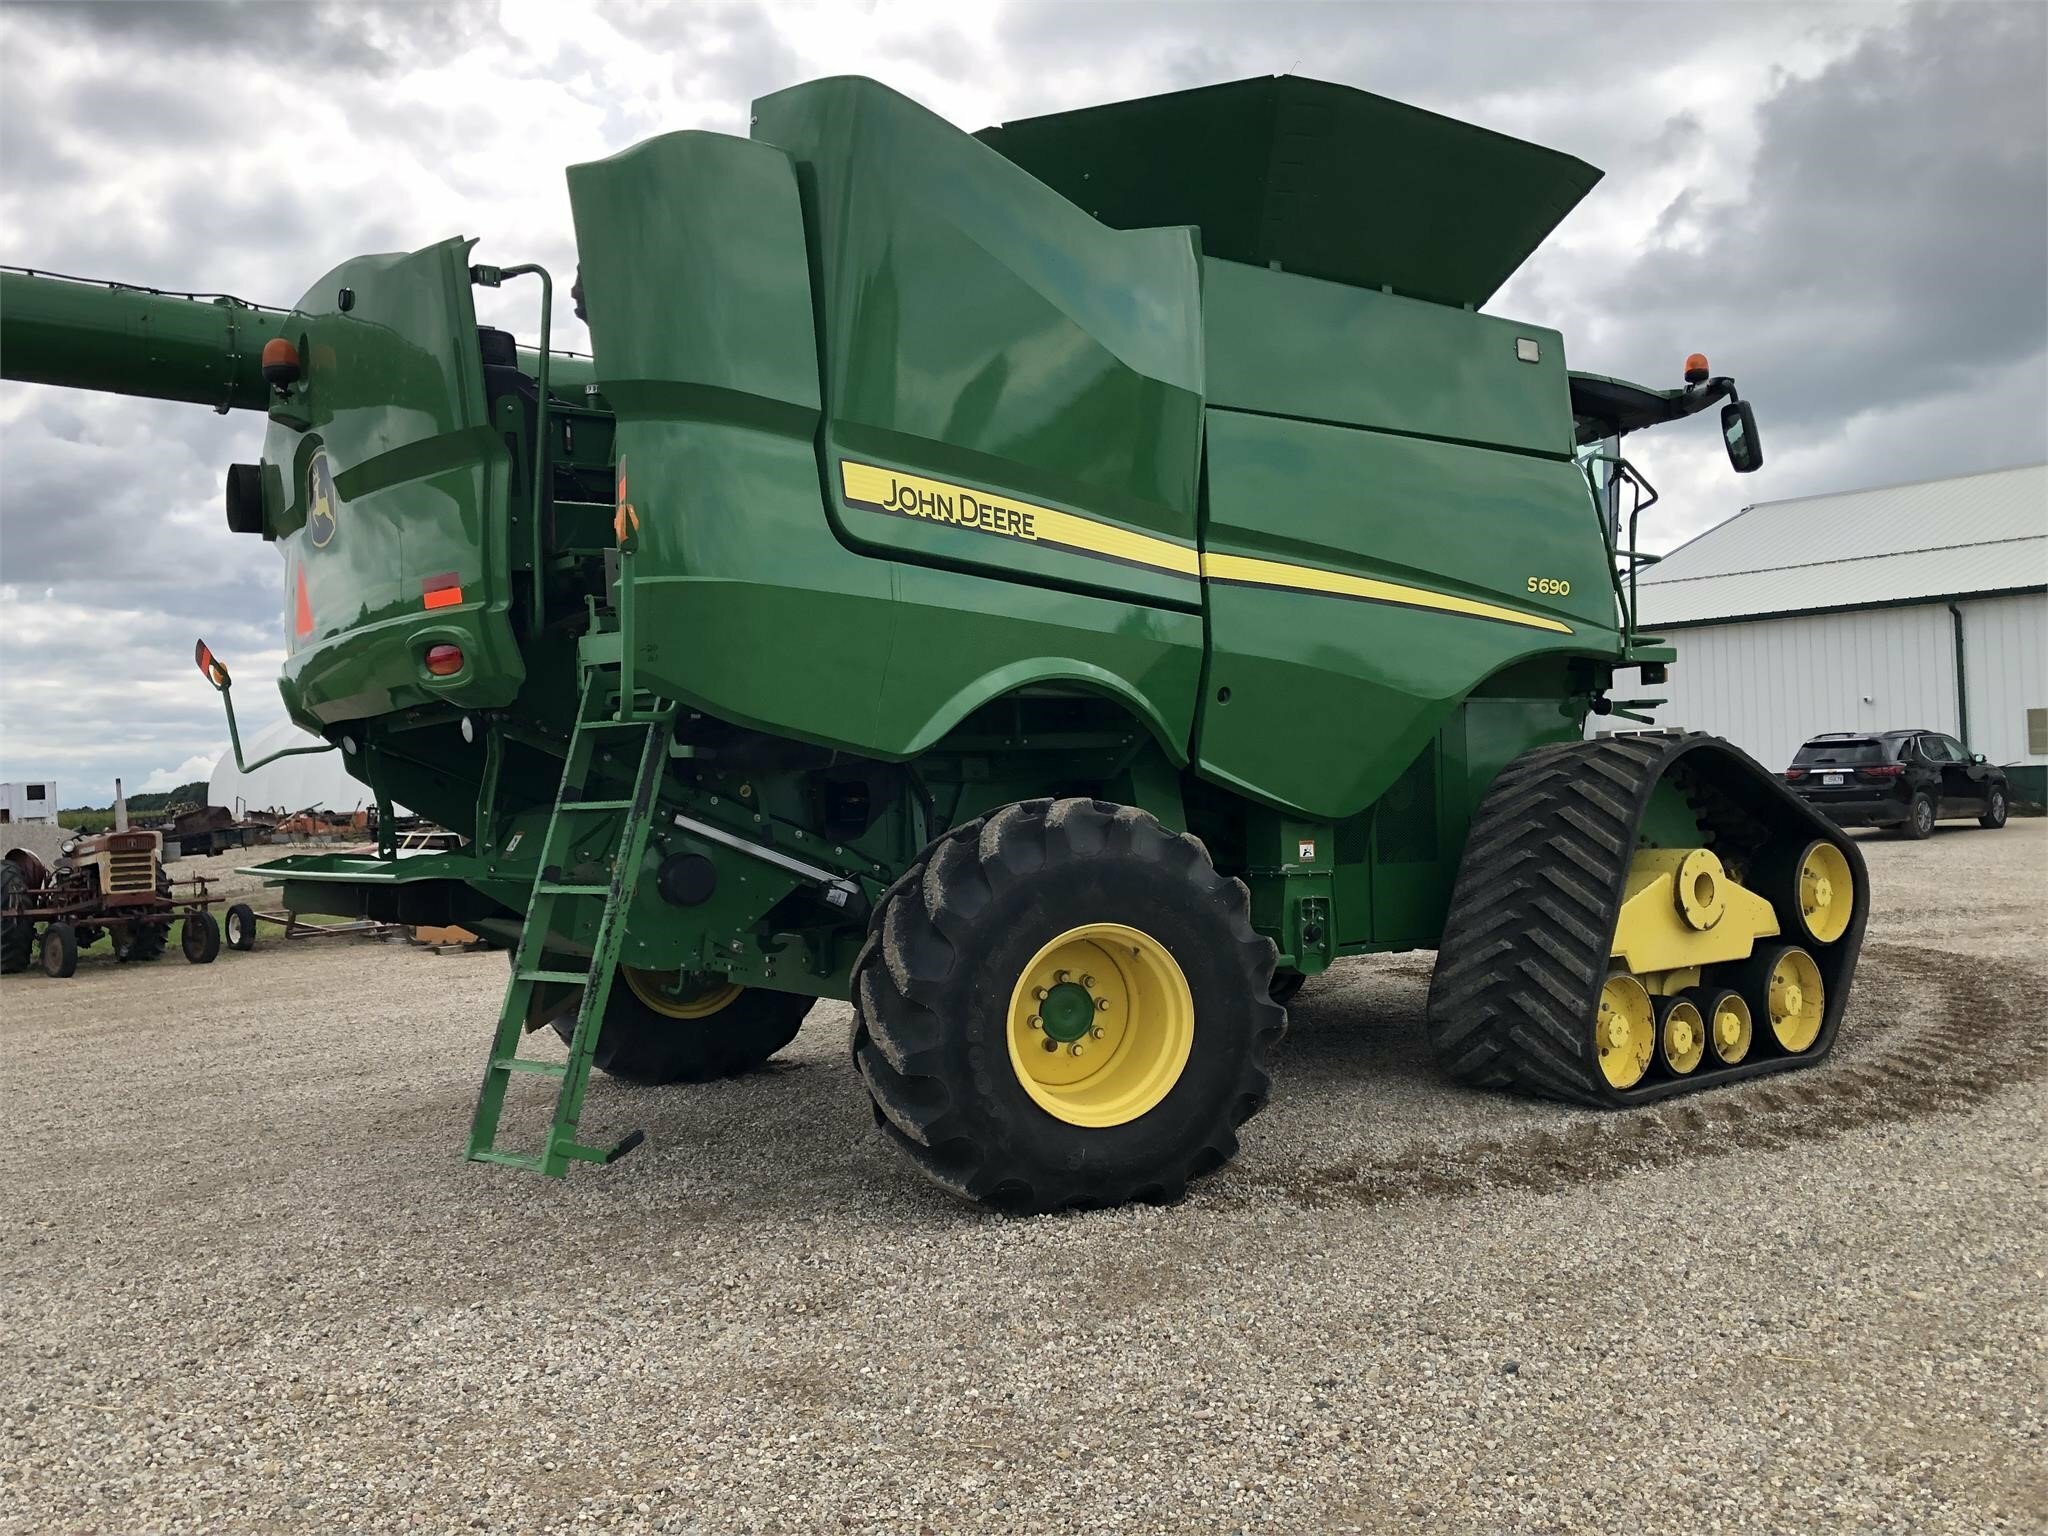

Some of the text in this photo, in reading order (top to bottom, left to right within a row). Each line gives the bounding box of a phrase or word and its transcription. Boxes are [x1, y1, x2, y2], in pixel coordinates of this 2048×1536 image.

[883, 479, 1035, 537] JOHN DEERE
[1527, 576, 1570, 596] S690
